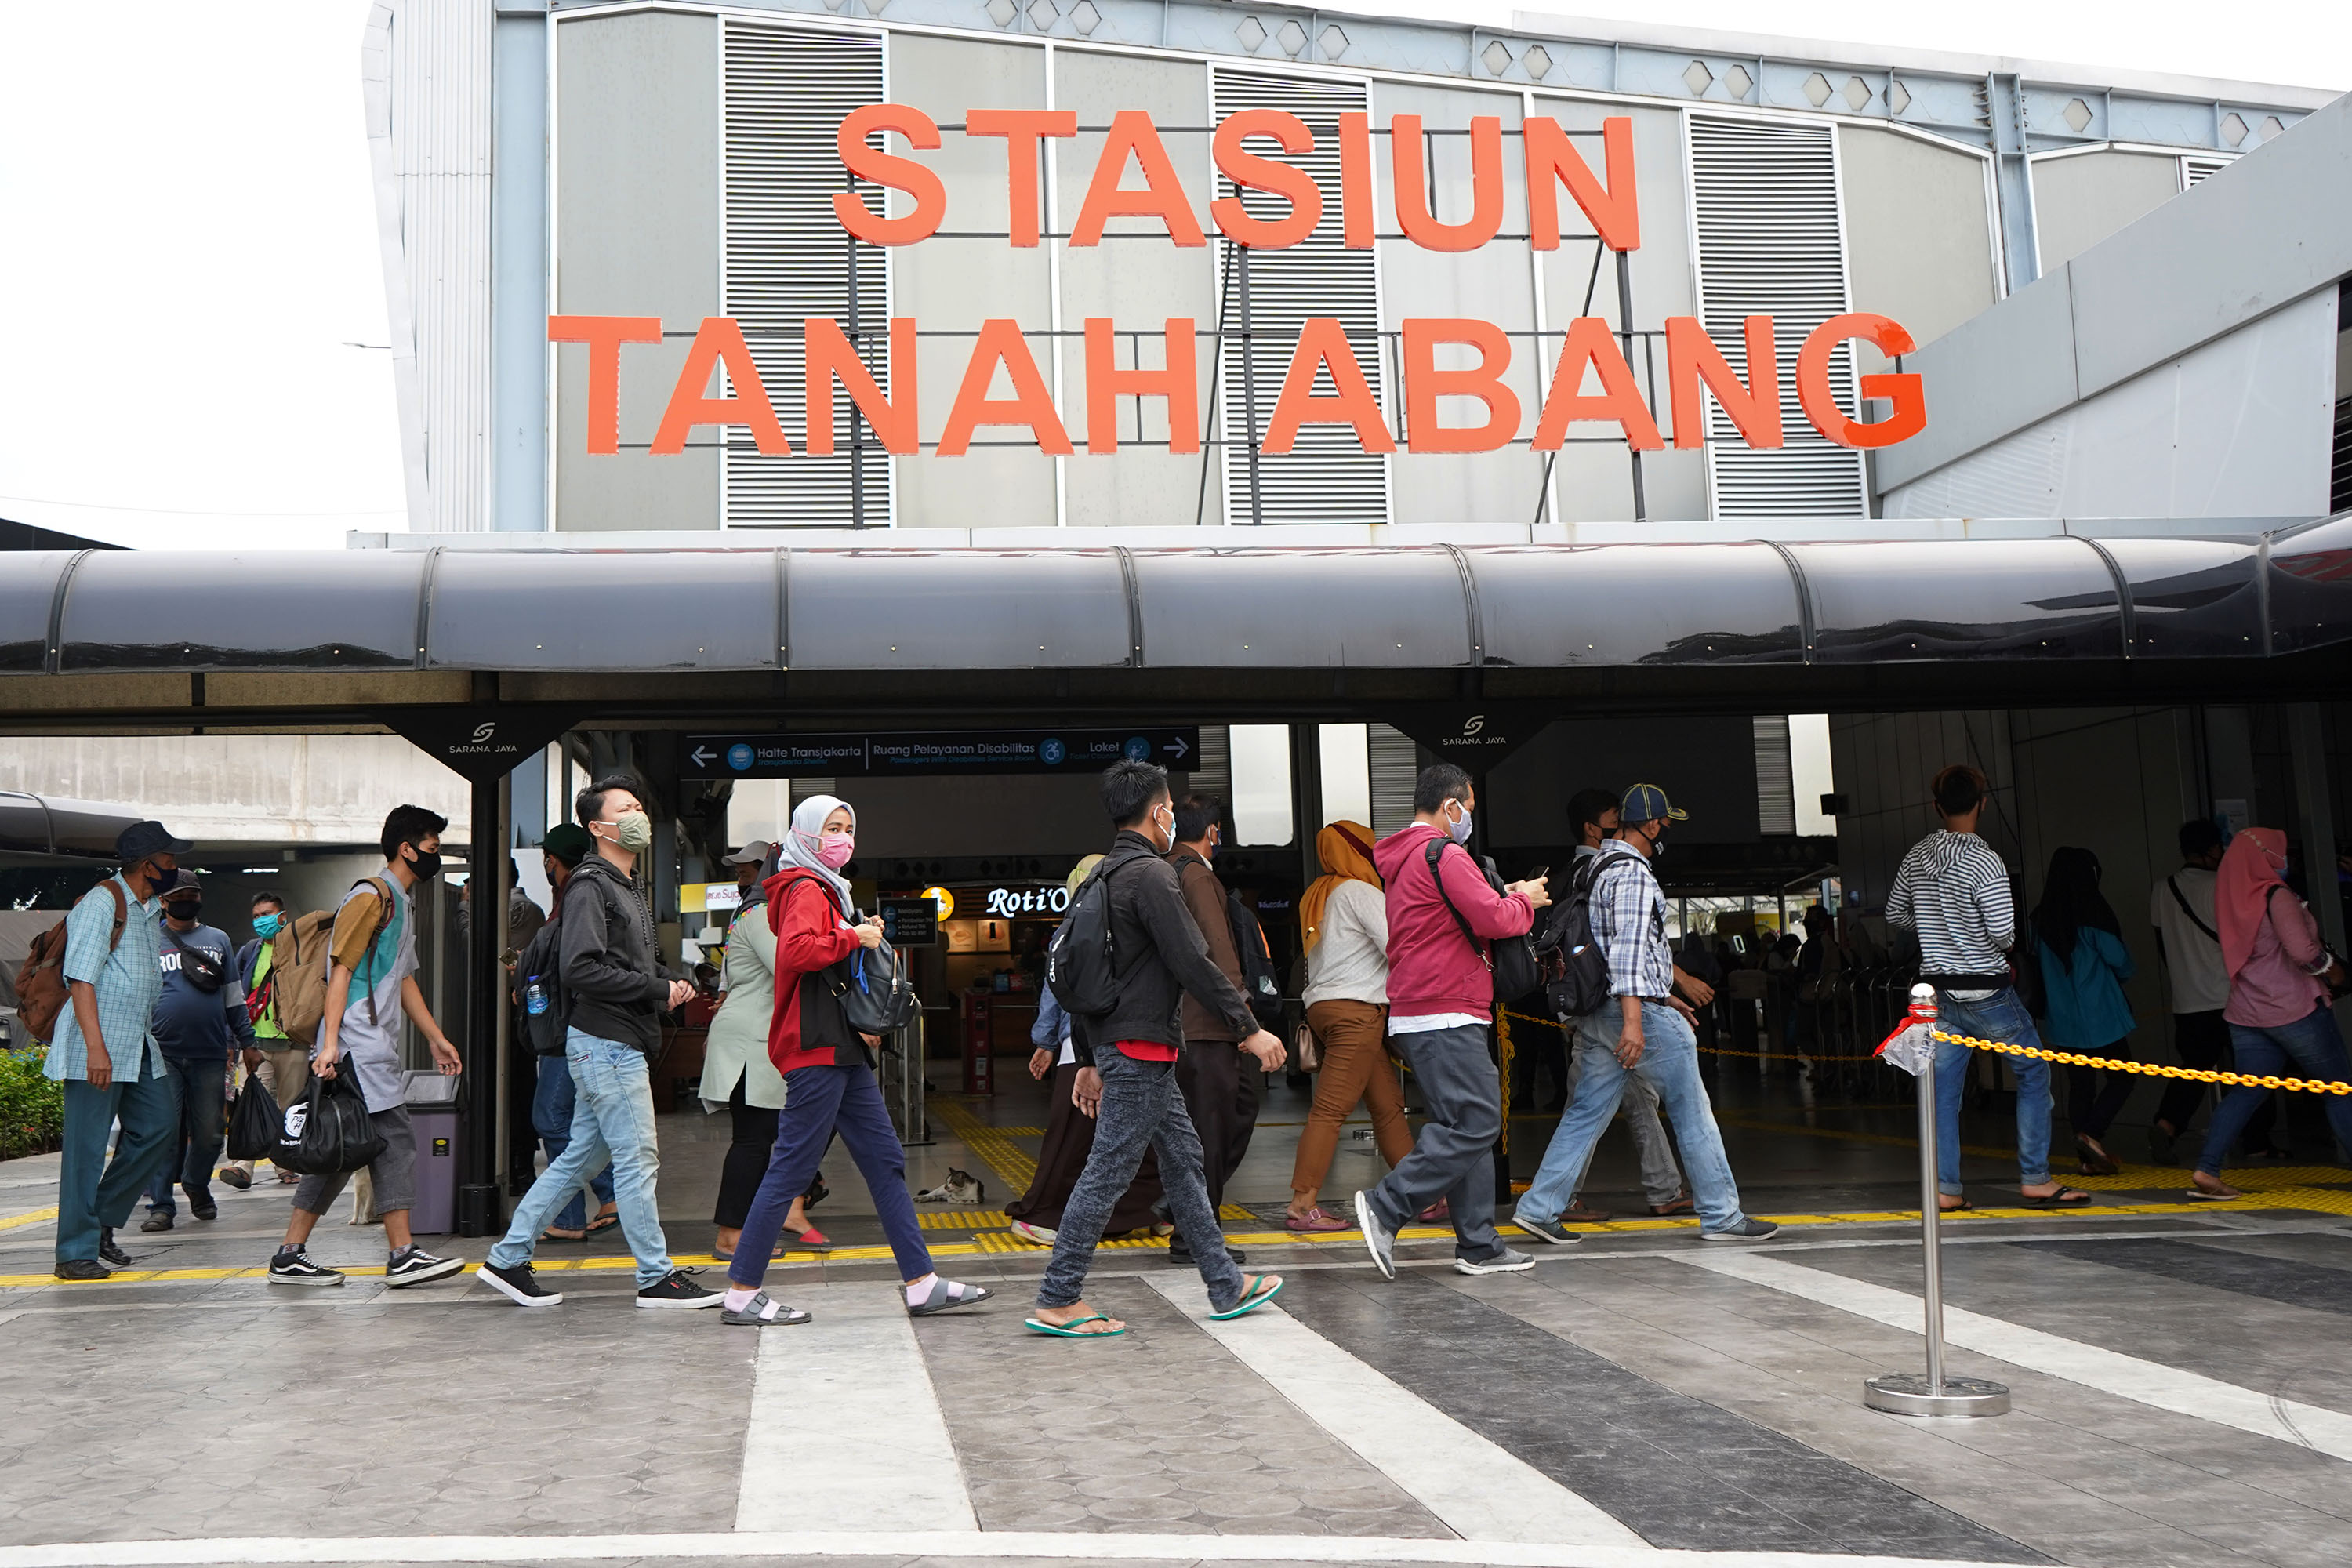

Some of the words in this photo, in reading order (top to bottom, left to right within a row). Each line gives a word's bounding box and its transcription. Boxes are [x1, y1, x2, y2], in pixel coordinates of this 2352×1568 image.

[833, 103, 1640, 252] STASIUN
[548, 315, 1200, 456] TANAH
[1261, 312, 1928, 453] ABANG
[757, 747, 788, 758] Halte
[790, 746, 862, 759] Transjakarta
[873, 745, 910, 757] Ruang
[913, 744, 974, 757] Pelayanan
[978, 742, 1035, 754] Disabilitas
[1090, 742, 1120, 753] Loket
[985, 887, 1070, 919] Roti'O
